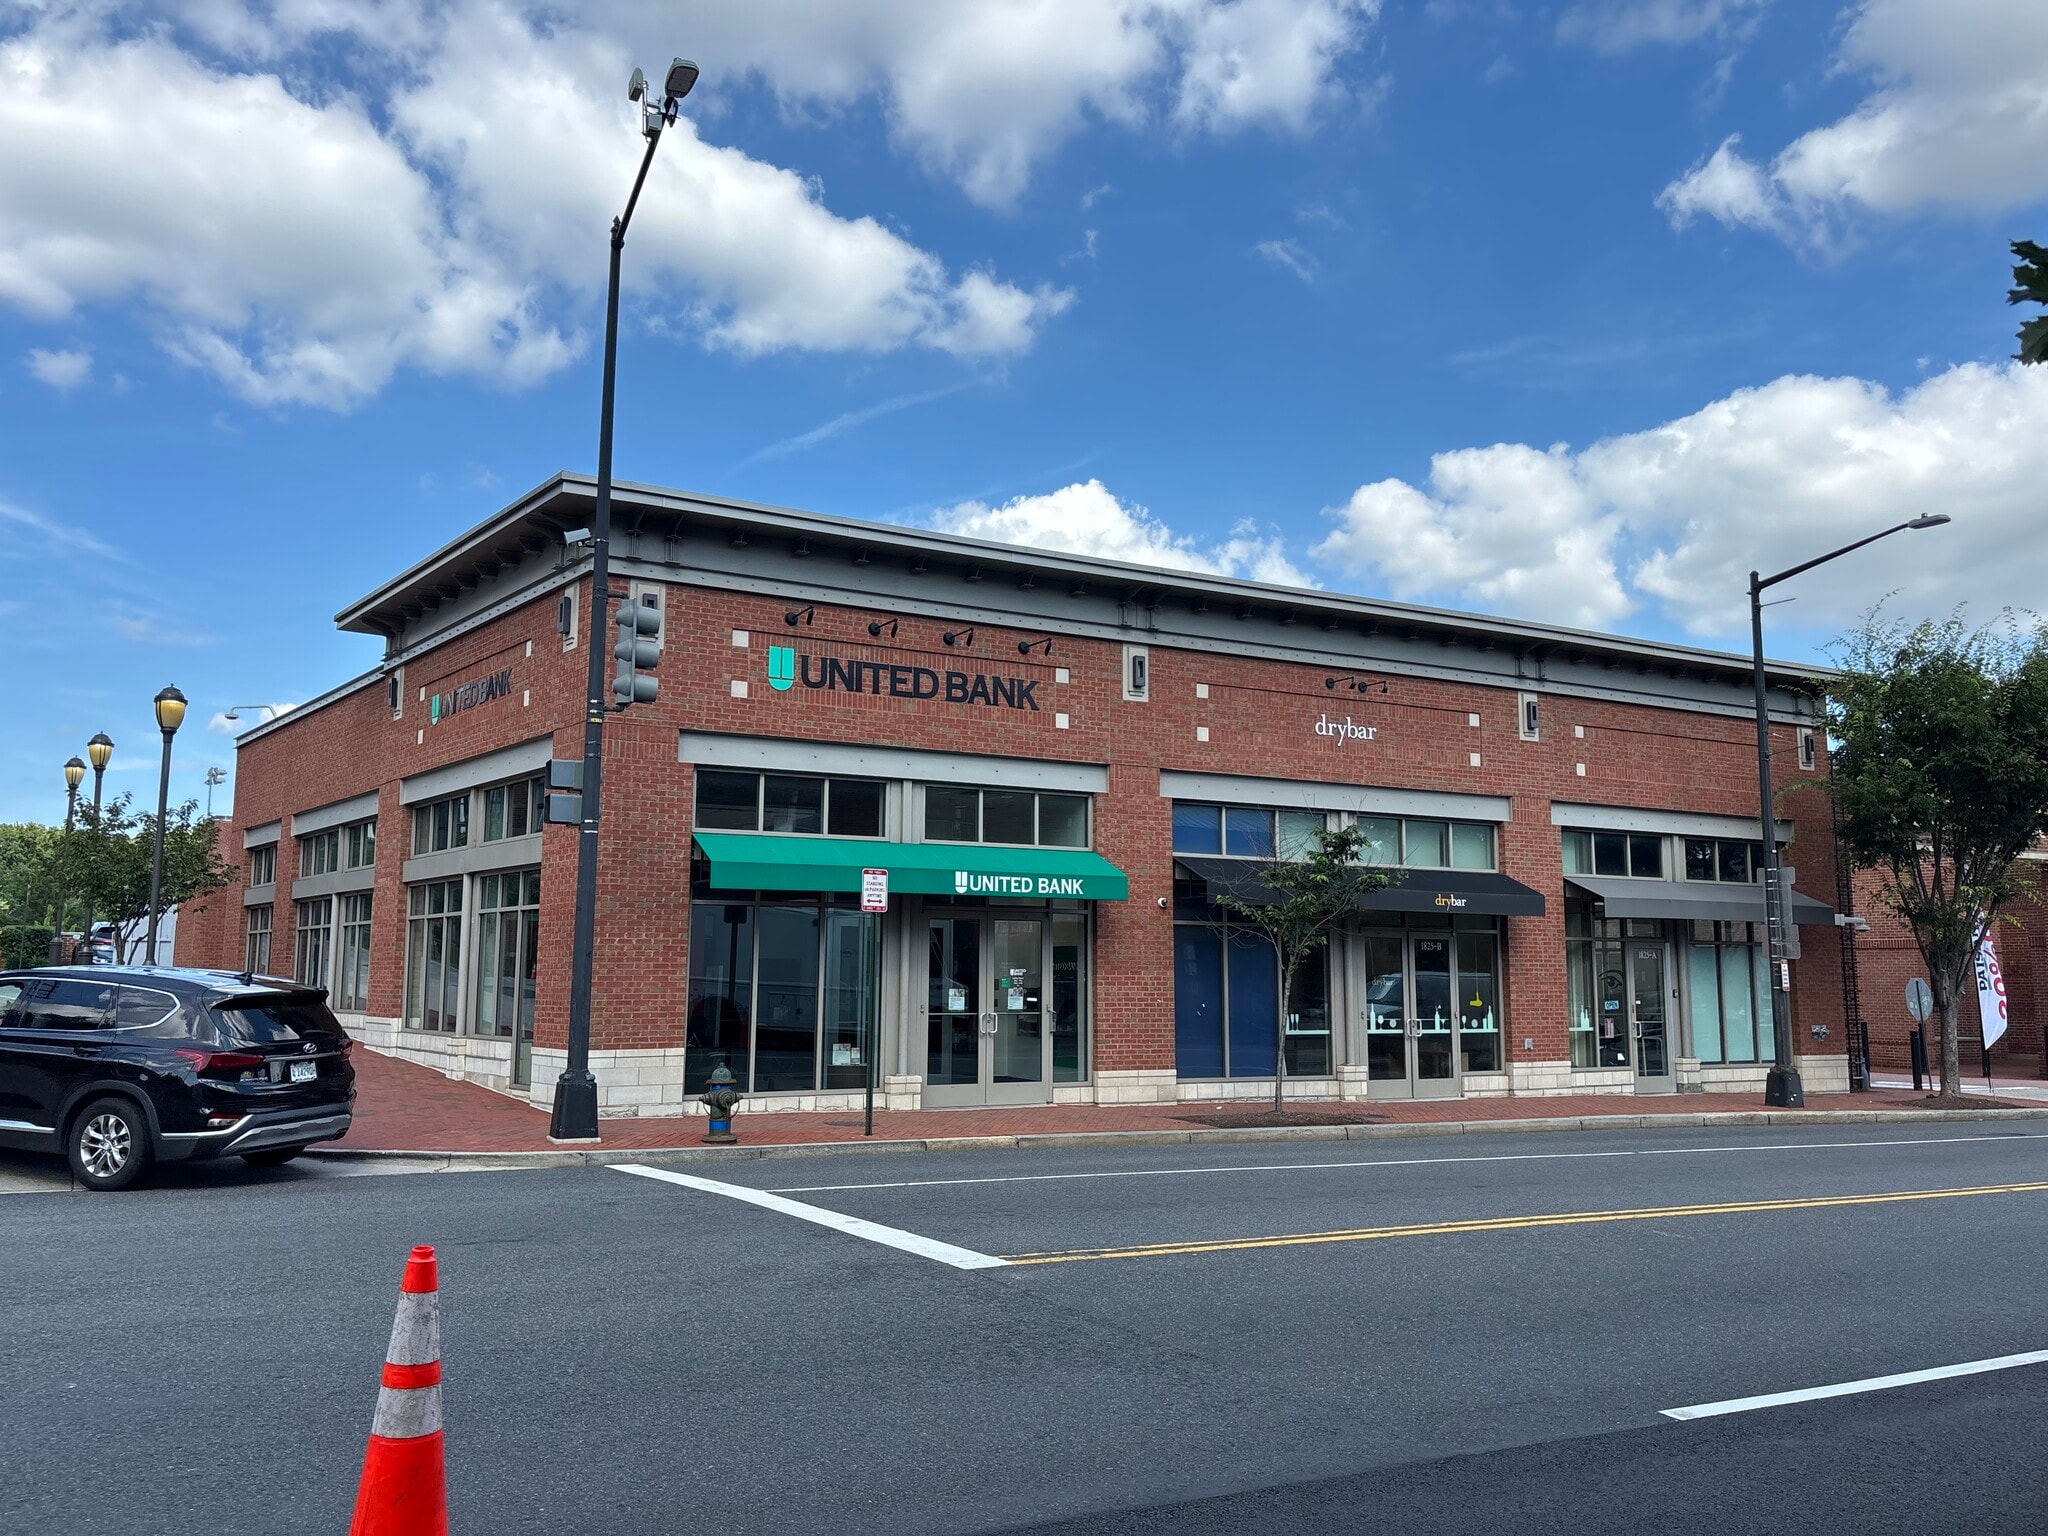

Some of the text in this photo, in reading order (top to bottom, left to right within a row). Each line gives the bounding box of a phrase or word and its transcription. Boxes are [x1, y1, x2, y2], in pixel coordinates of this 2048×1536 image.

[801, 655, 1040, 711] UNITED BANK
[440, 668, 513, 719] UNITED BANK
[1315, 714, 1377, 747] drybar
[969, 875, 1084, 895] UNITED BANK
[1435, 894, 1467, 911] drybar
[1421, 942, 1442, 951] 1825-B
[1638, 951, 1657, 959] 1825-A
[1372, 977, 1395, 989] drybar
[1605, 1001, 1618, 1009] OPEN
